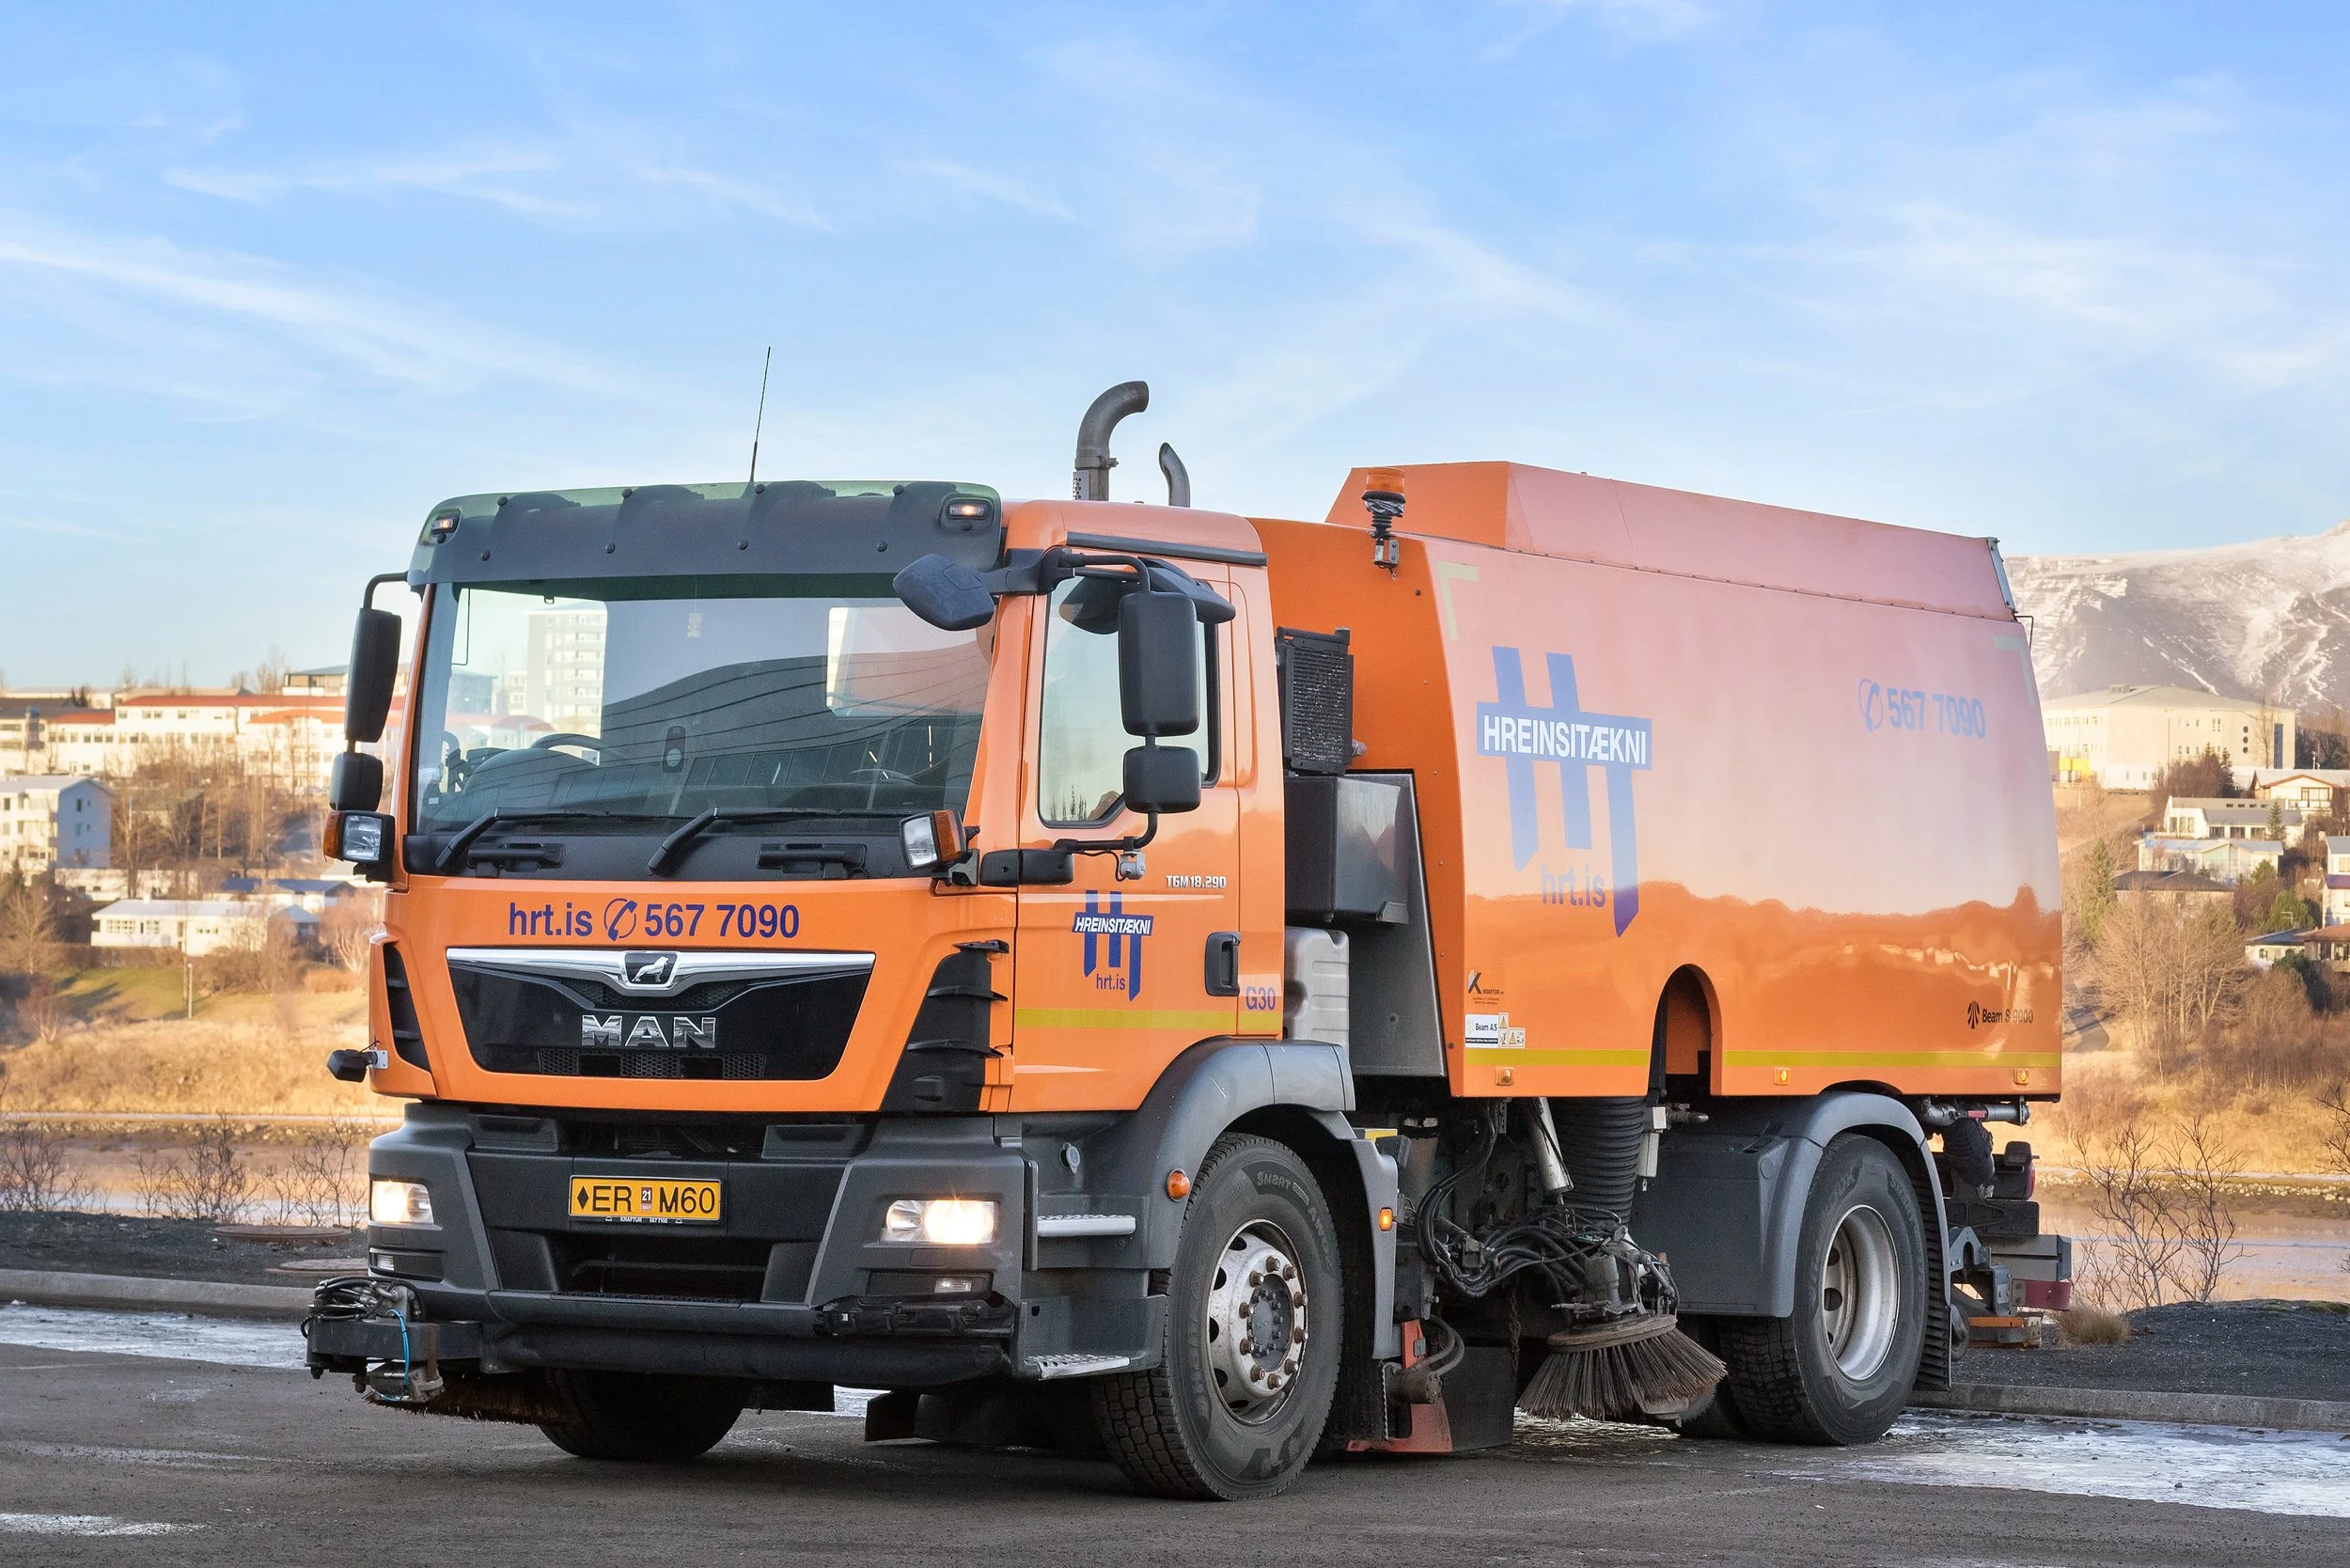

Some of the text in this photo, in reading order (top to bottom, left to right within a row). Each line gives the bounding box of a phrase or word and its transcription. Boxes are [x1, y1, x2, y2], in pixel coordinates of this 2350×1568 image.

[1887, 687, 1985, 739] 567 7090
[1483, 714, 1646, 765] HREINSITÆKNI
[1166, 875, 1227, 888] TGM 18.290
[1541, 861, 1606, 907] hrt.is
[509, 902, 800, 938] hrt.is 567 7090
[1074, 917, 1152, 935] HREINSITÆKNI
[1096, 973, 1126, 991] hrt.is
[1246, 986, 1277, 1011] G30
[1475, 1023, 1489, 1031] Beam
[1982, 1009, 2034, 1024] Beam S 9000
[581, 1014, 717, 1049] MAN
[592, 1185, 715, 1215] ER M60
[642, 1188, 652, 1202] 21
